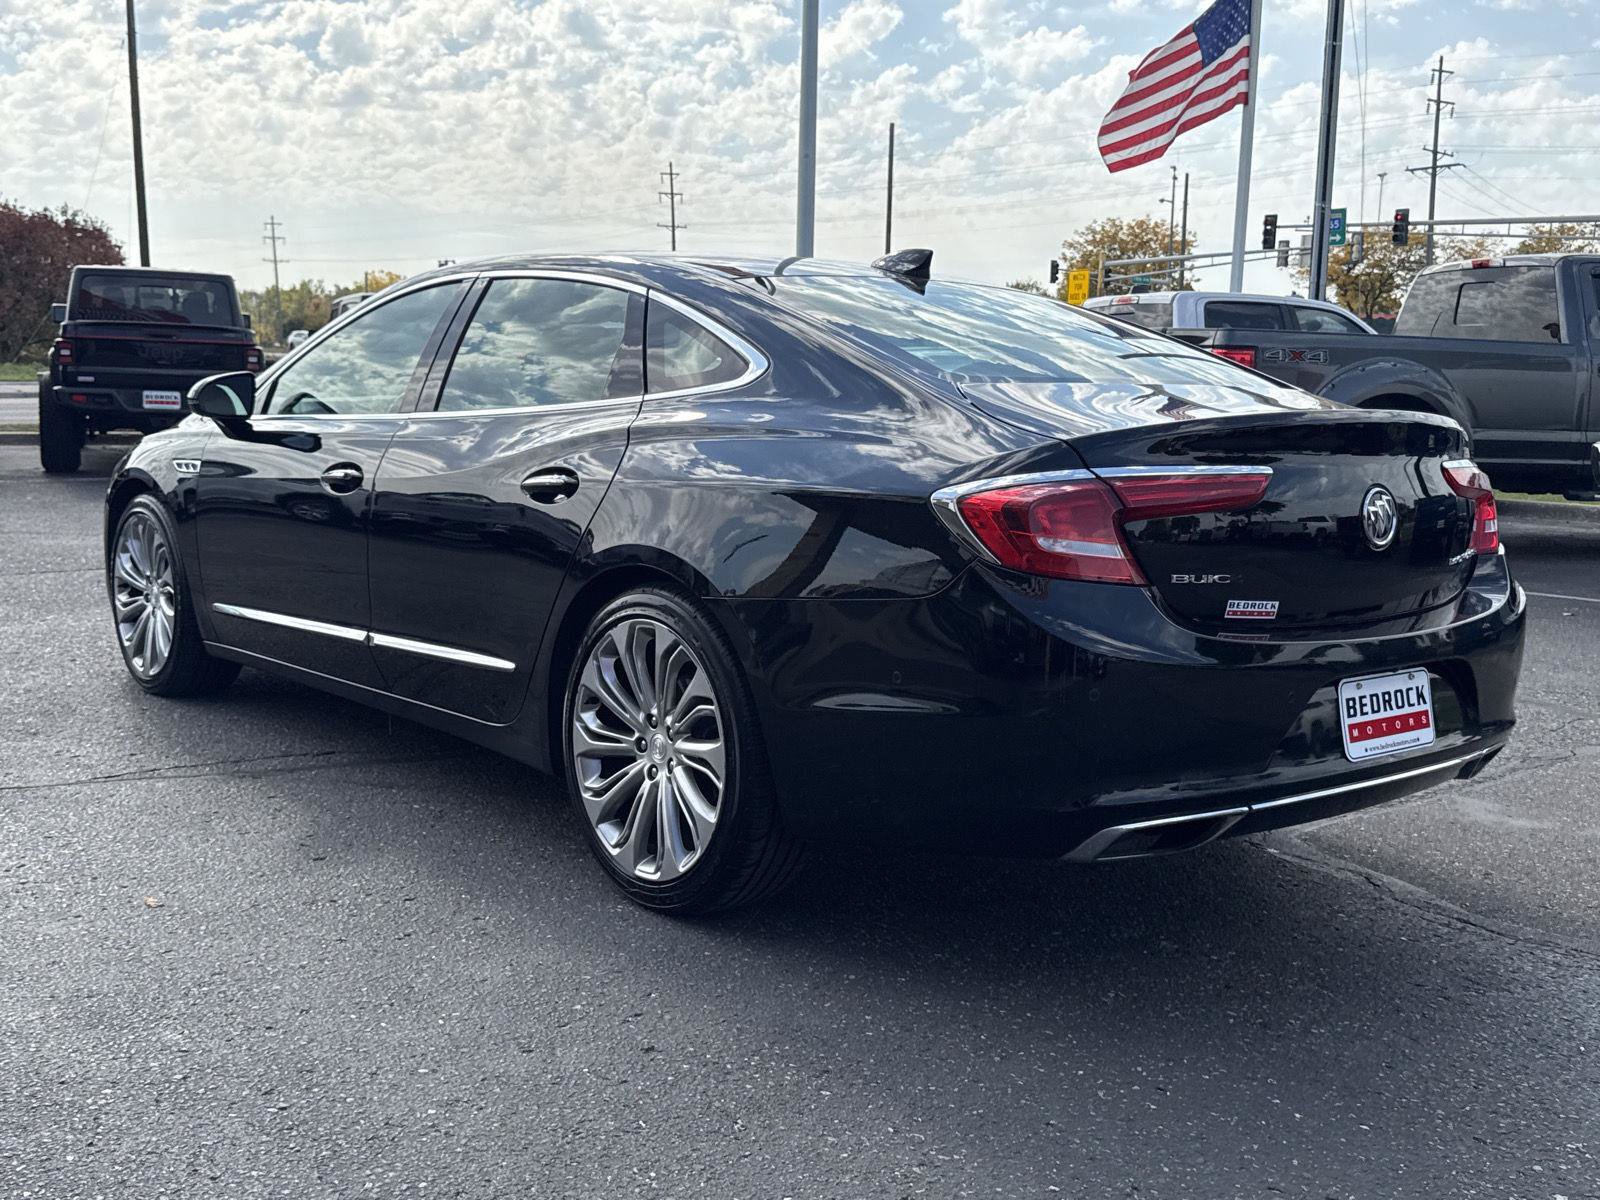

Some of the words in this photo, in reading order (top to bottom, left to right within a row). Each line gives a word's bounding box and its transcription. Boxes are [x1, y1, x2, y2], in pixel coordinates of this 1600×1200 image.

[1228, 601, 1277, 610] BEDROCK
[1345, 685, 1427, 718] BEDROCK
[1352, 715, 1427, 737] MOTORS
